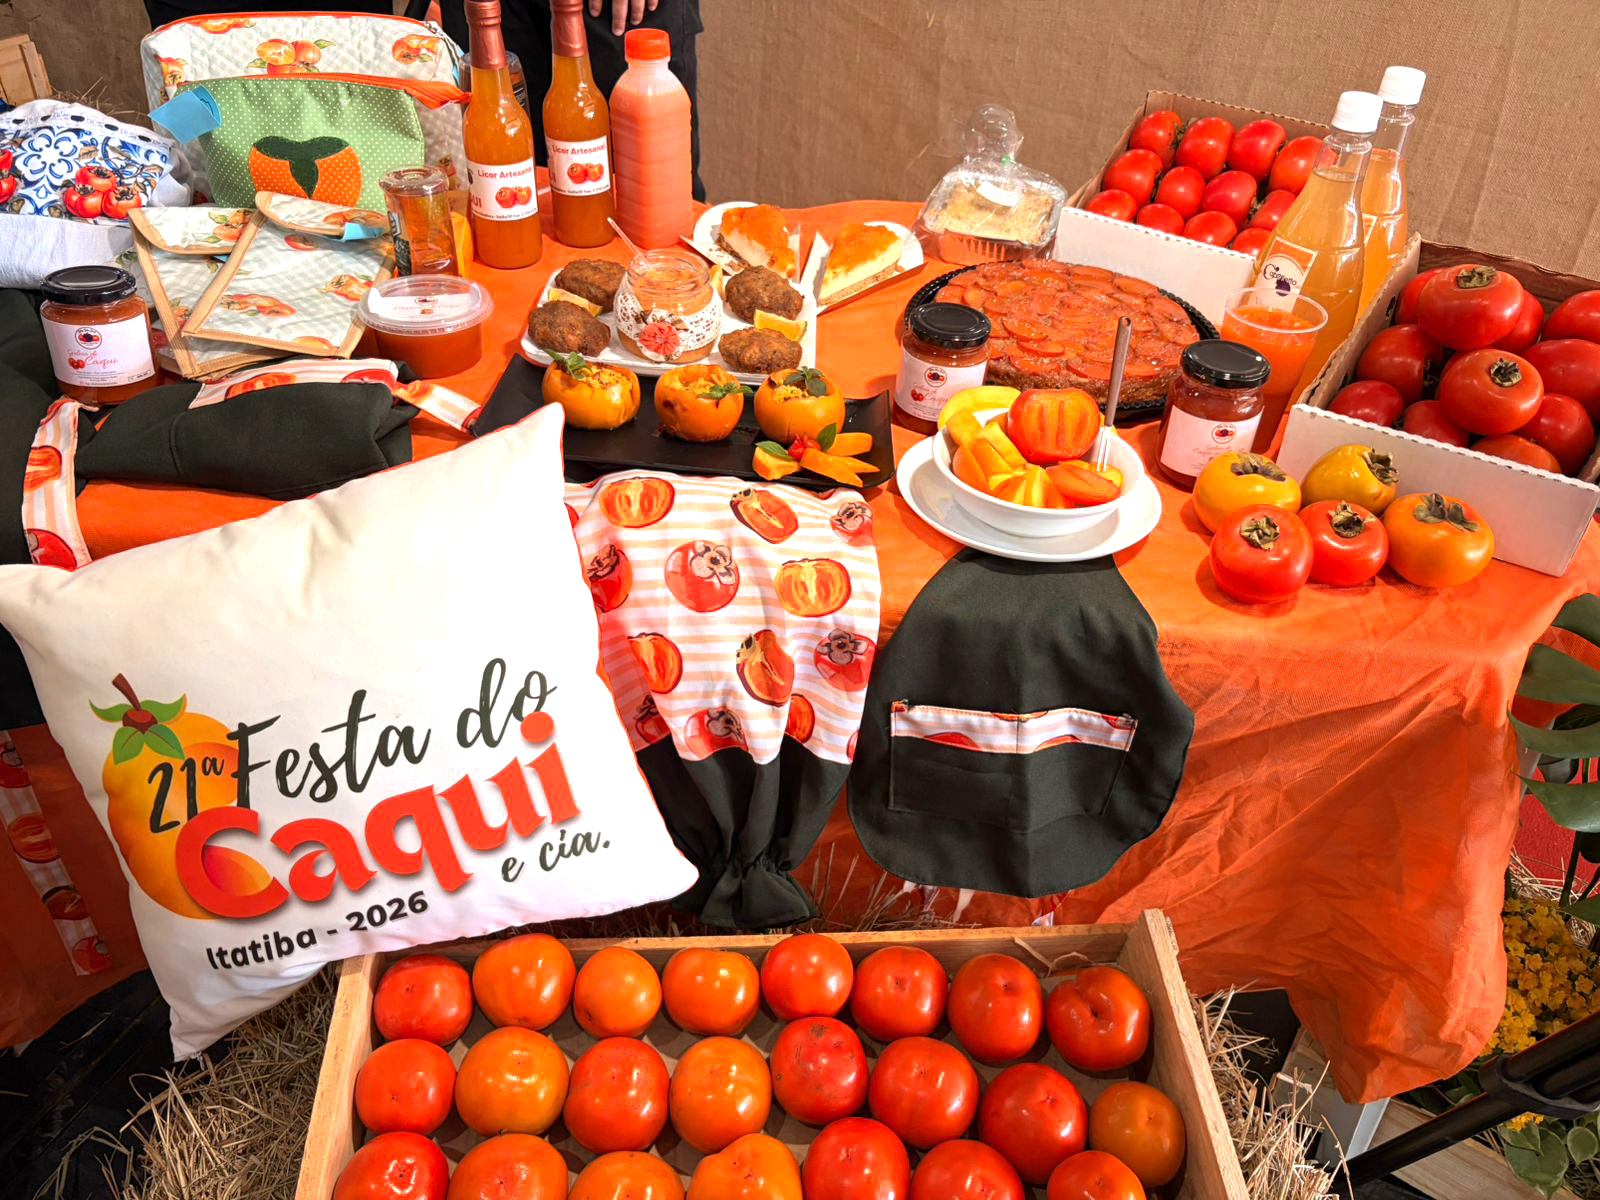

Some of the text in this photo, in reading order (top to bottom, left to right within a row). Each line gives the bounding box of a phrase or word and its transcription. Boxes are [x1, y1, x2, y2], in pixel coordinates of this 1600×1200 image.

[552, 143, 608, 155] Licor Artesanal
[477, 166, 533, 179] Licor Artesanal
[85, 355, 119, 369] Caqui
[226, 688, 433, 810] Festa
[456, 657, 558, 750] do
[174, 711, 583, 920] Caqui
[500, 856, 526, 883] e
[205, 924, 318, 971] Itatiba
[345, 889, 430, 934] 2026
